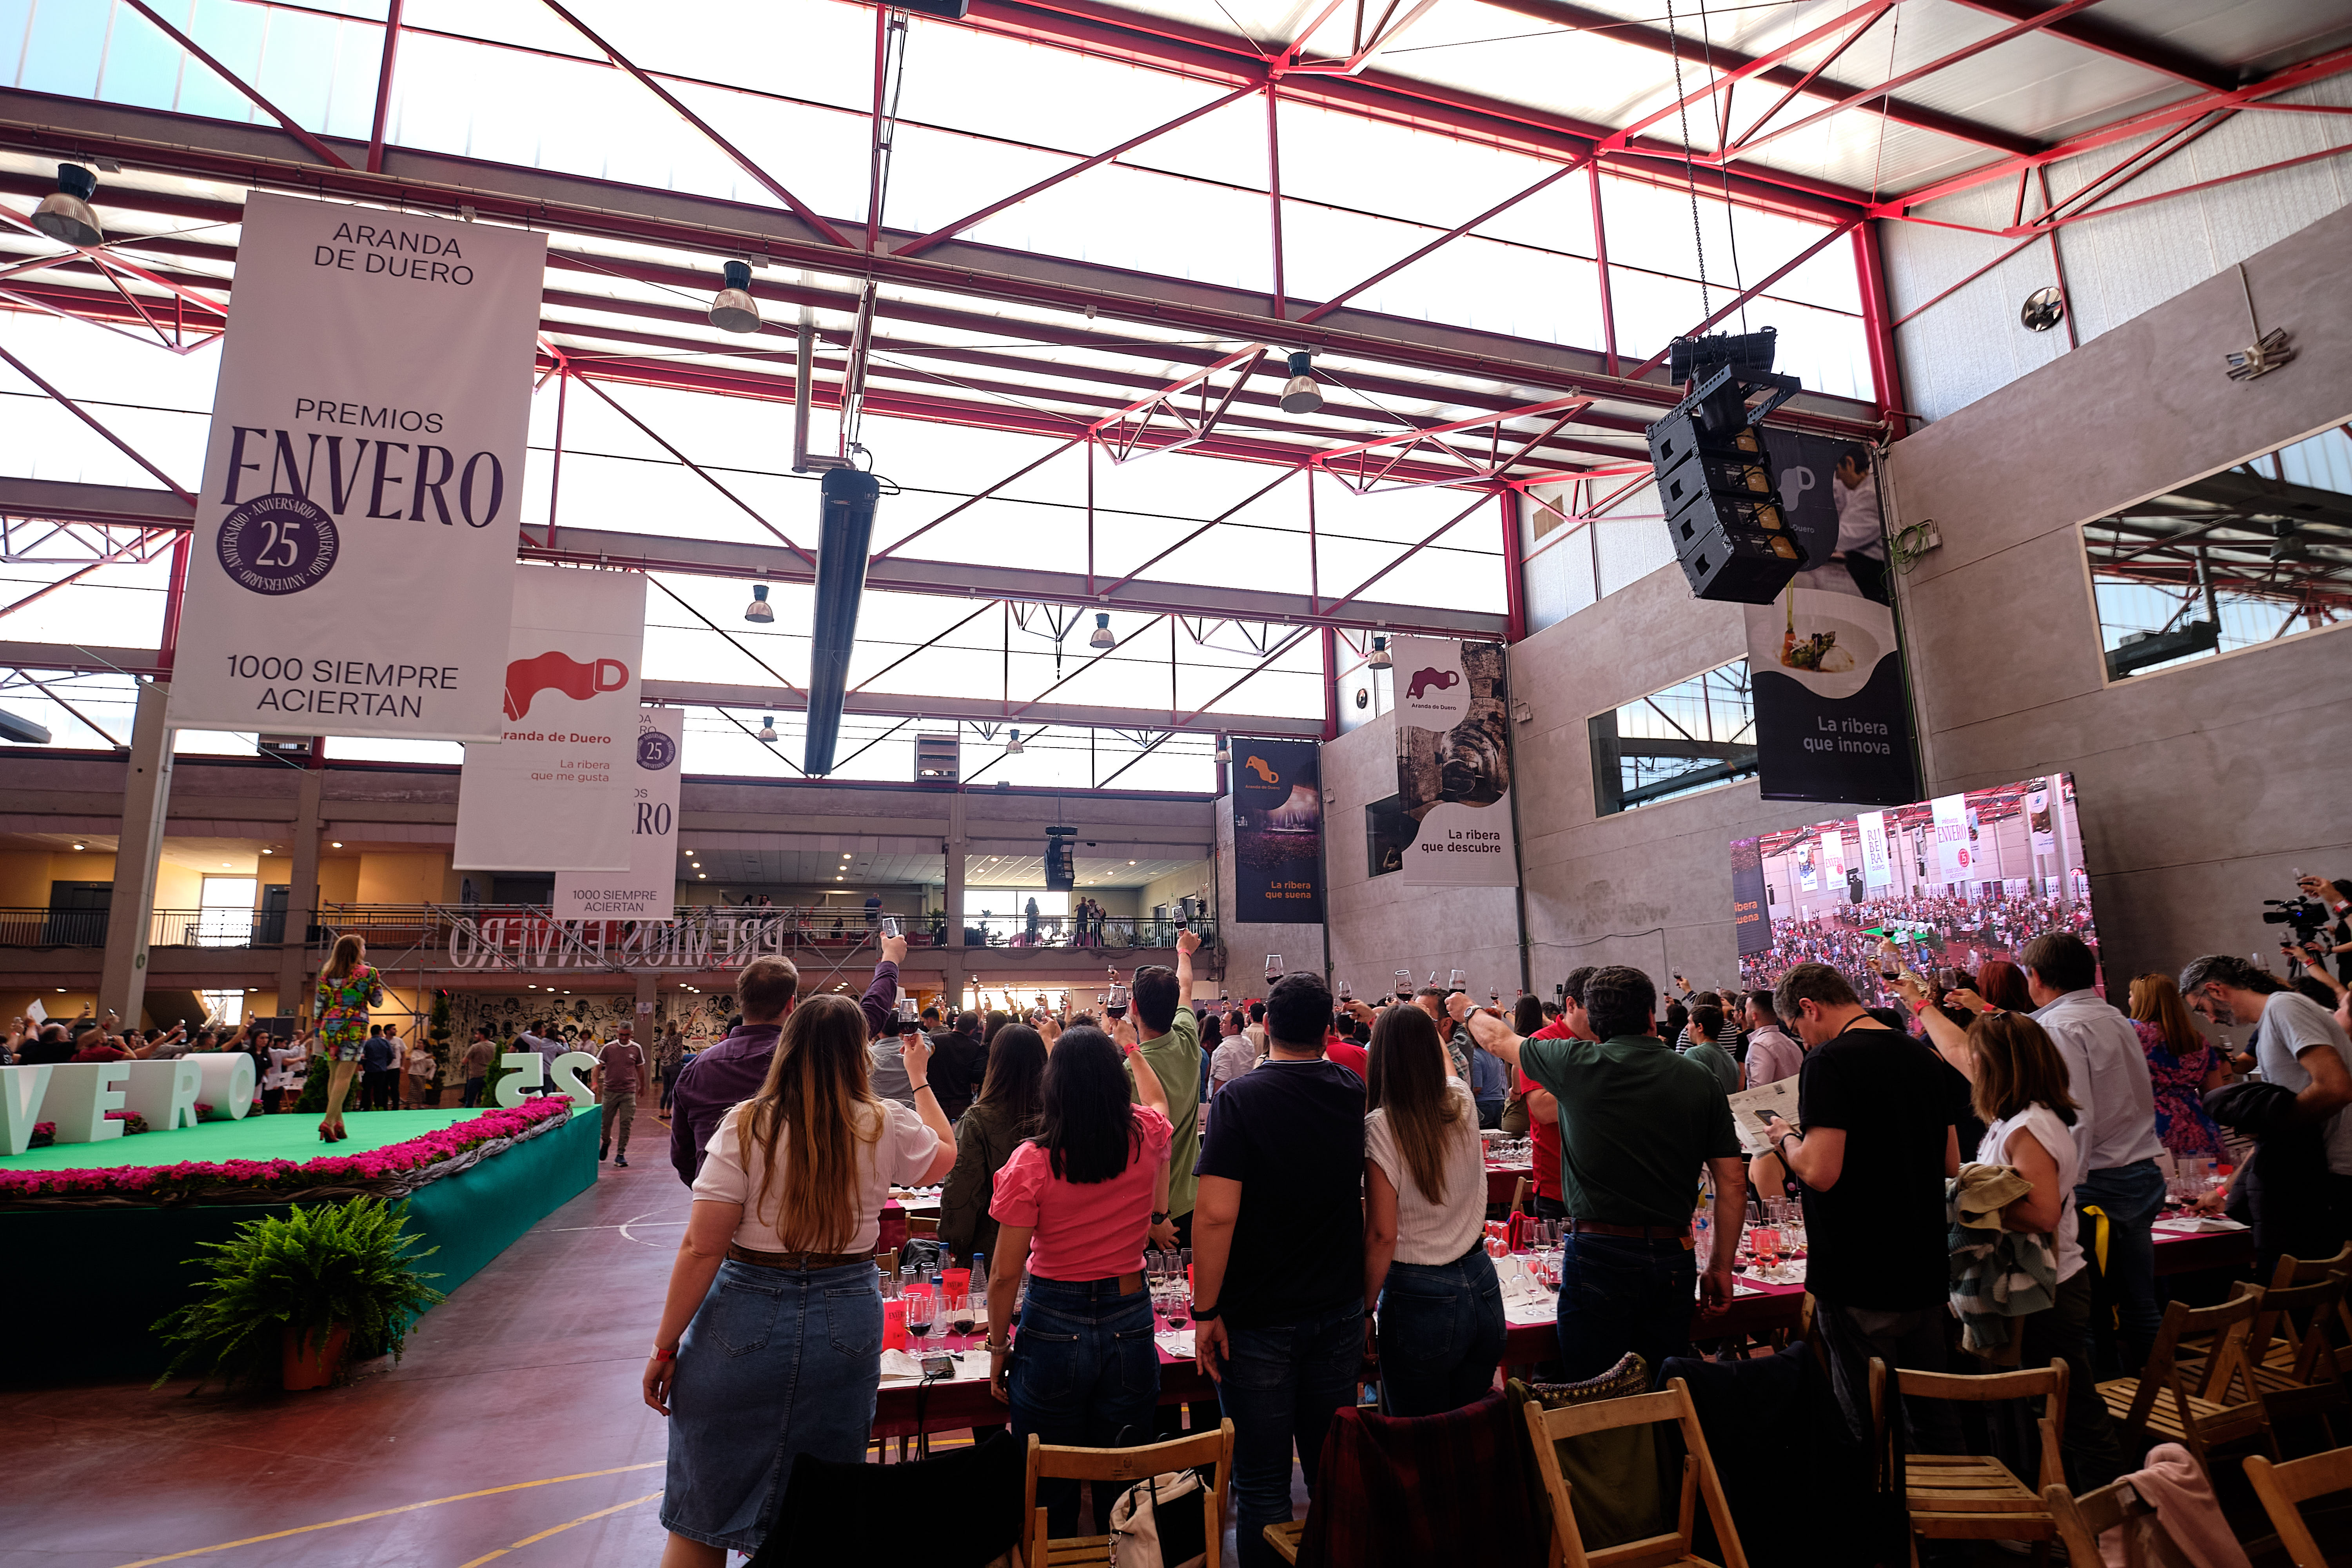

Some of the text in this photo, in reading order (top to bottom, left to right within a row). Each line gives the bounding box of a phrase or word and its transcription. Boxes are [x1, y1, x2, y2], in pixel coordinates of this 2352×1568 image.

[332, 222, 462, 259] ARANDA
[314, 245, 474, 285] DE DUERO
[295, 397, 444, 433] PREMIOS
[220, 425, 504, 528] ENVERO
[252, 497, 317, 519] ANIVERSARIO
[222, 512, 249, 568] ANIVERSARIO
[256, 521, 300, 567] 25
[314, 521, 334, 575] ANIVERSARIO
[240, 570, 306, 591] ANIVERSARIO
[227, 654, 459, 689] 1000 SIEMPRE
[256, 688, 422, 718] ACIERTAN
[1817, 715, 1888, 735] La ribera
[501, 731, 611, 744] randa de Duero
[1804, 736, 1890, 755] que innova
[646, 742, 662, 760] 25
[560, 760, 610, 769] La ribera
[531, 772, 553, 780] que
[578, 773, 609, 783] gusta
[632, 803, 671, 835] RO
[1449, 829, 1500, 840] La ribera
[1937, 824, 1967, 843] ENVERO
[1422, 842, 1501, 853] que descubre
[573, 890, 657, 900] 1000 SIEMPRE
[1285, 881, 1311, 889] ribera
[584, 902, 644, 912] ACIERTAN
[1734, 901, 1757, 912] ibera
[0, 1052, 257, 1155] VERO
